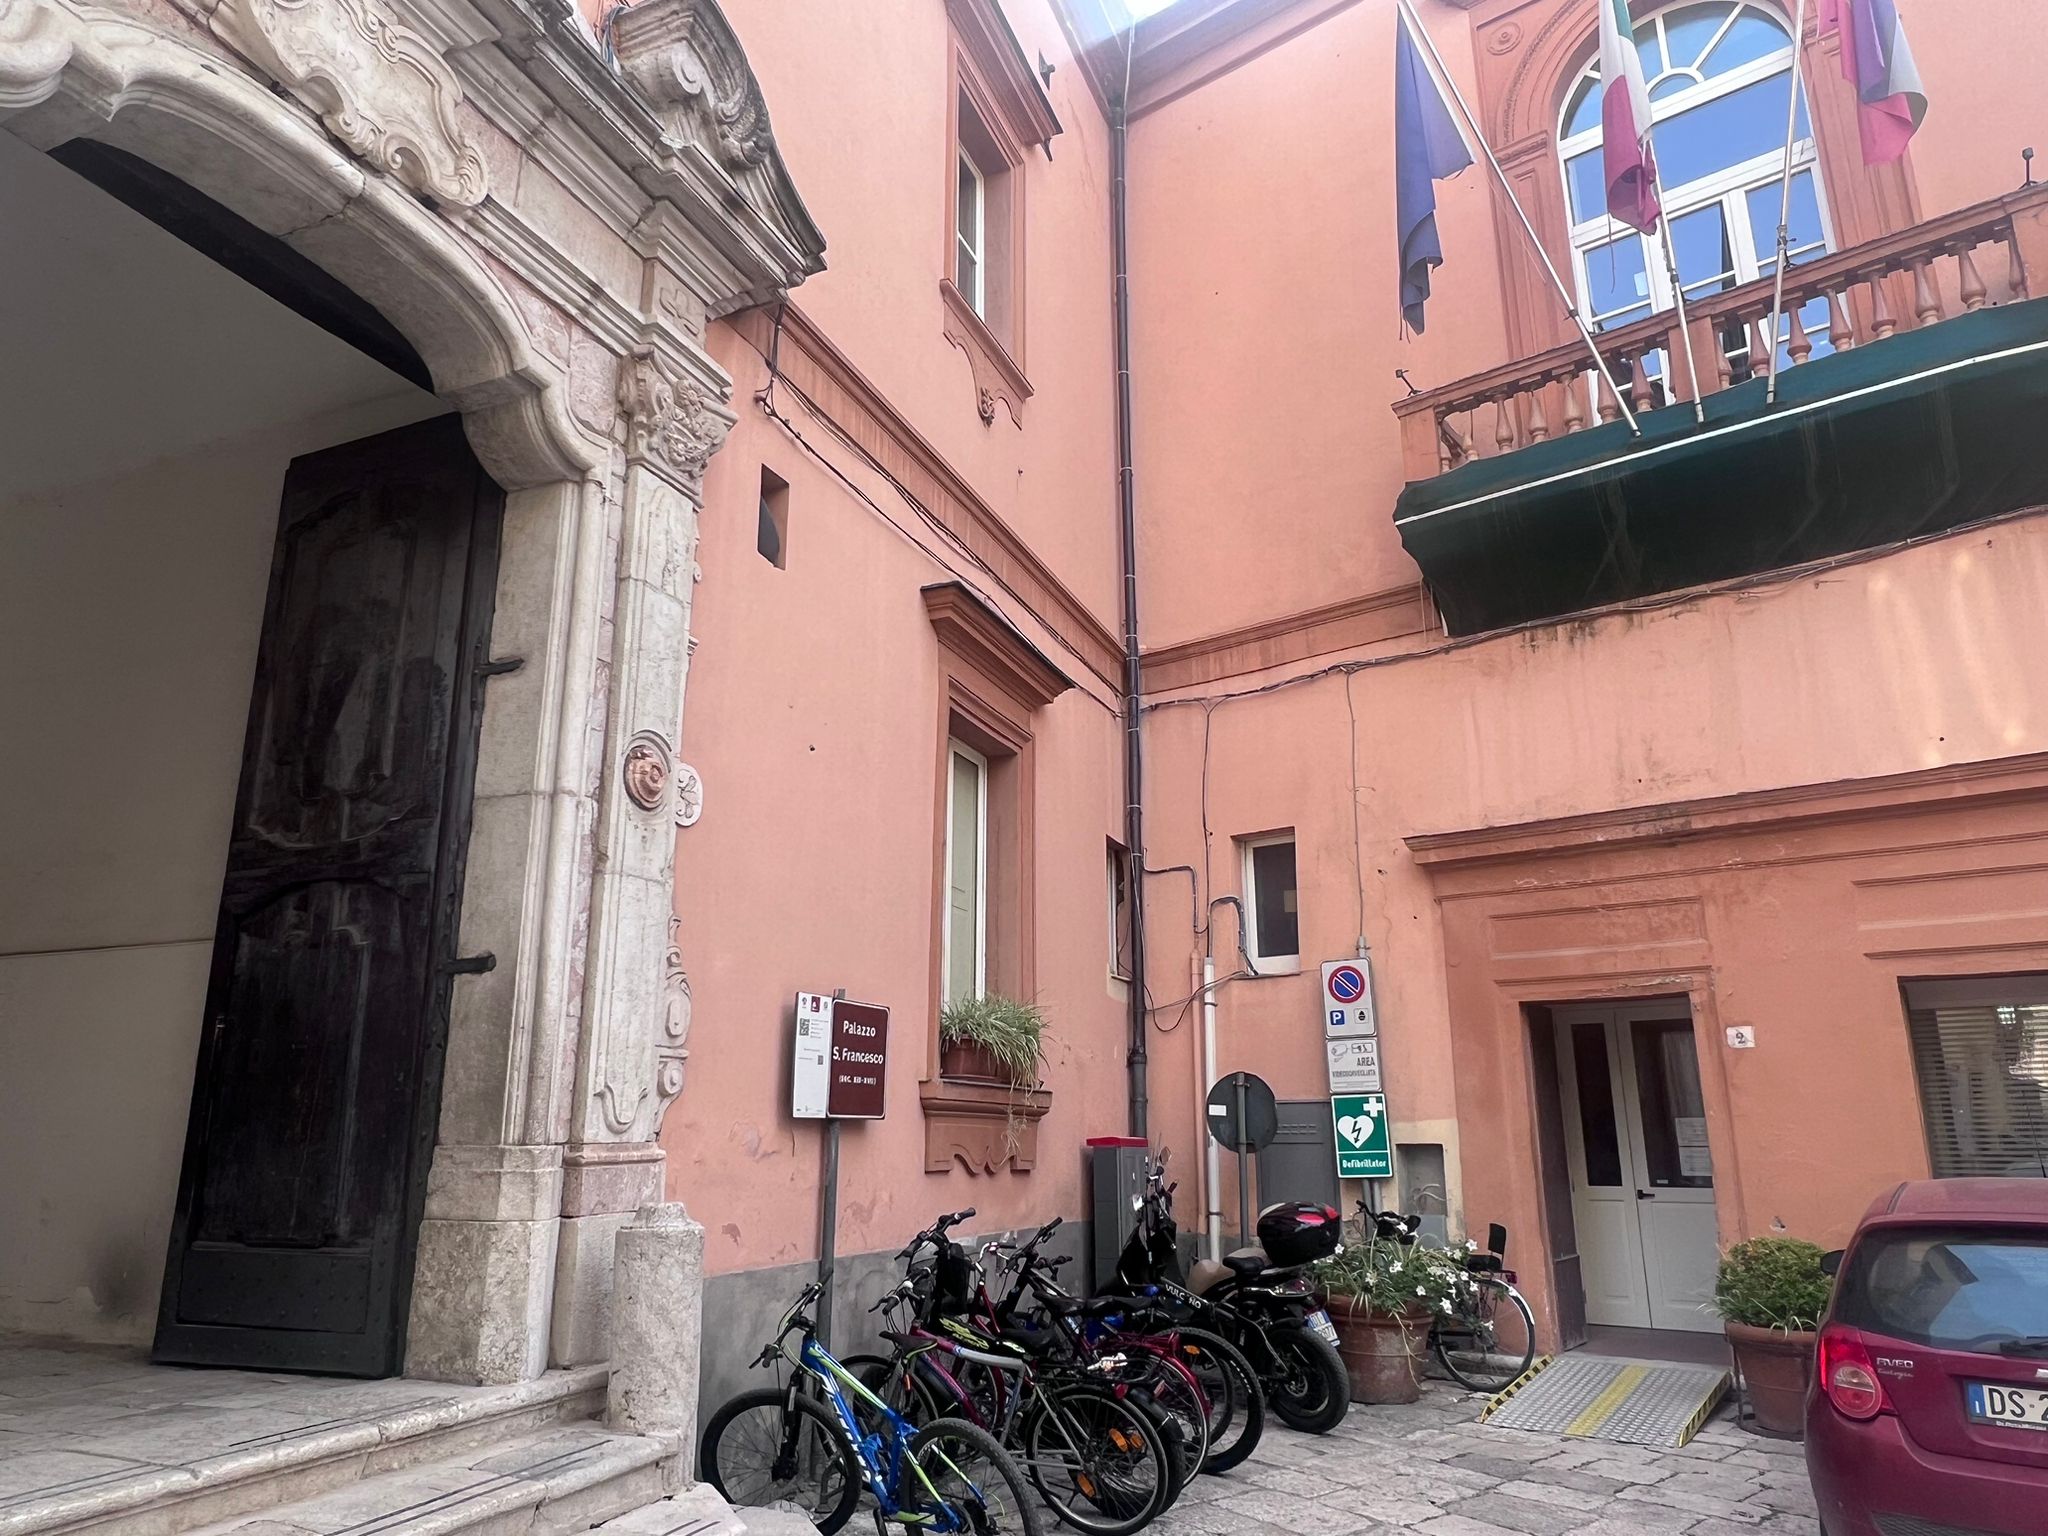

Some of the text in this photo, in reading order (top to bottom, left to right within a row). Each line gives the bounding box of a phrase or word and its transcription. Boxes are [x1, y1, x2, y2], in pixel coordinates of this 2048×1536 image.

[1332, 1011, 1342, 1024] P
[843, 1020, 876, 1037] Palazzo
[1735, 1032, 1746, 1044] 2
[832, 1046, 884, 1065] S. Francesco
[1356, 1056, 1376, 1067] AREA
[1342, 1159, 1387, 1168] Defibrillator
[1165, 1283, 1202, 1309] VULCNO
[1876, 1356, 1914, 1369] AVEO
[1988, 1387, 2026, 1418] DS
